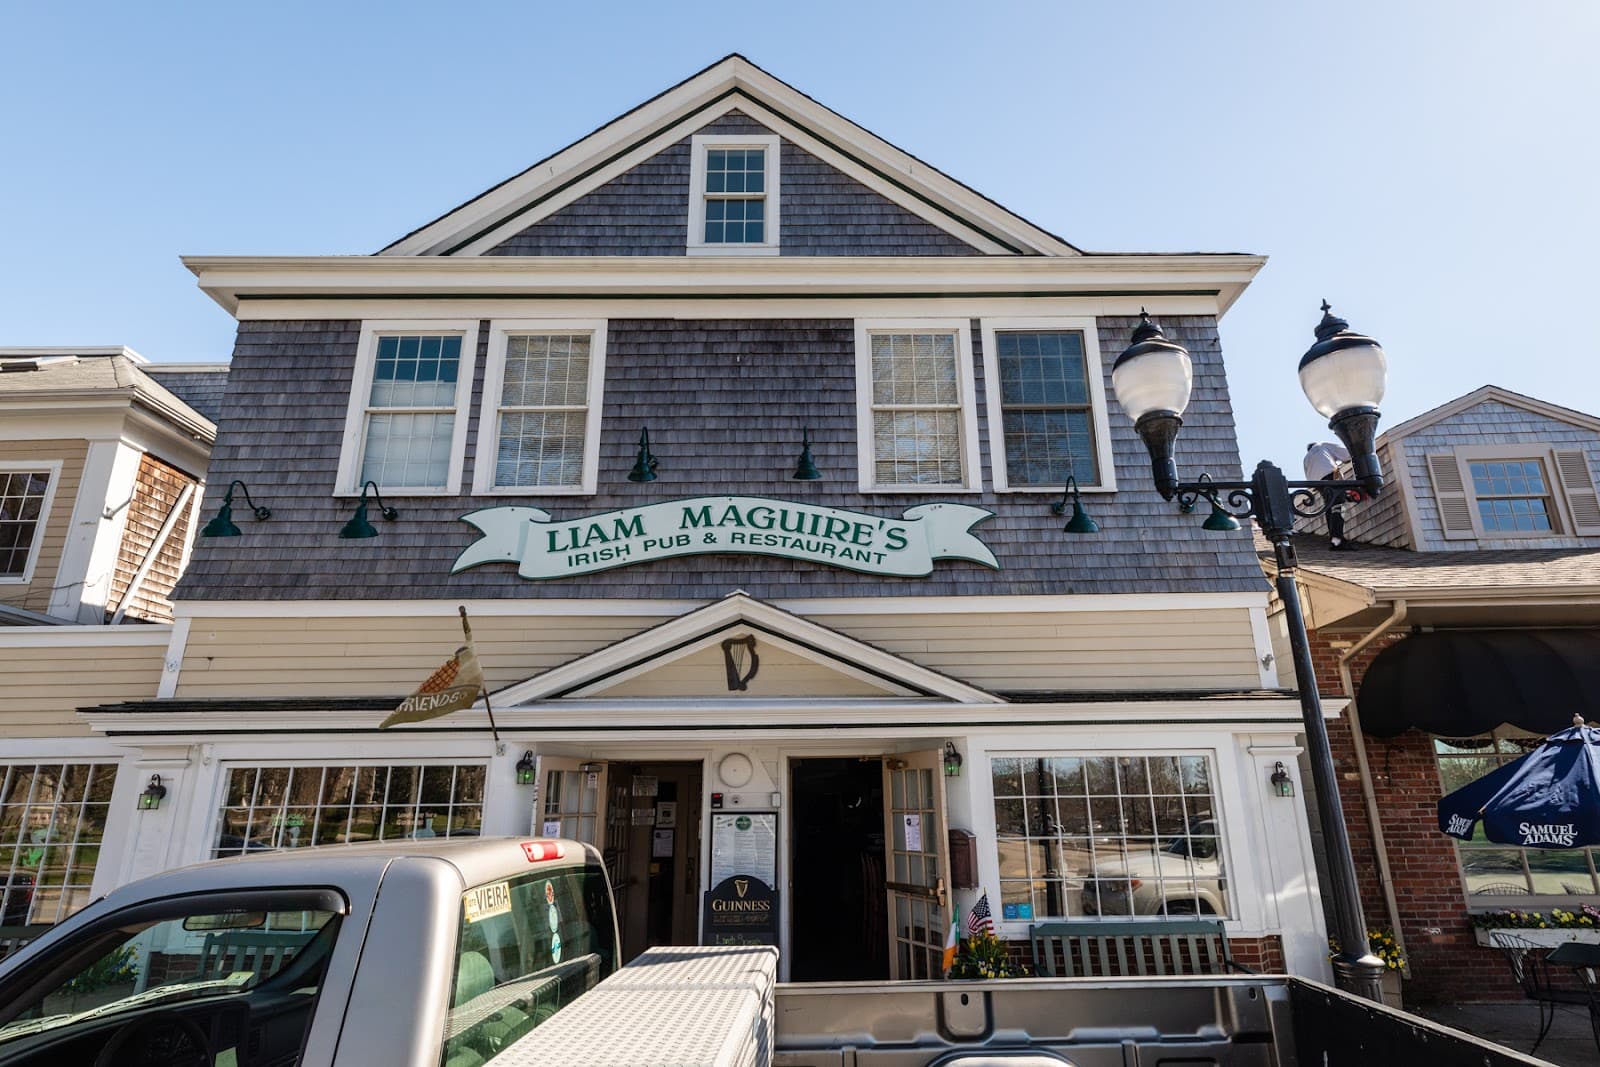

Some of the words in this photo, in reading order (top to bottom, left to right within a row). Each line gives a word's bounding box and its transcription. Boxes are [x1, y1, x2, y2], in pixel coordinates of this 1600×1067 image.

[546, 514, 647, 553] LIAM
[679, 504, 909, 551] MAGUIRE'S
[568, 544, 631, 567] IRISH
[643, 534, 691, 552] PUB
[703, 532, 717, 544] &
[731, 532, 887, 565] RESTAURANT
[1519, 822, 1578, 836] SAMUEL
[1522, 832, 1573, 846] ADAMS
[475, 884, 509, 911] VIEIRA
[712, 899, 770, 912] GUINNESS
